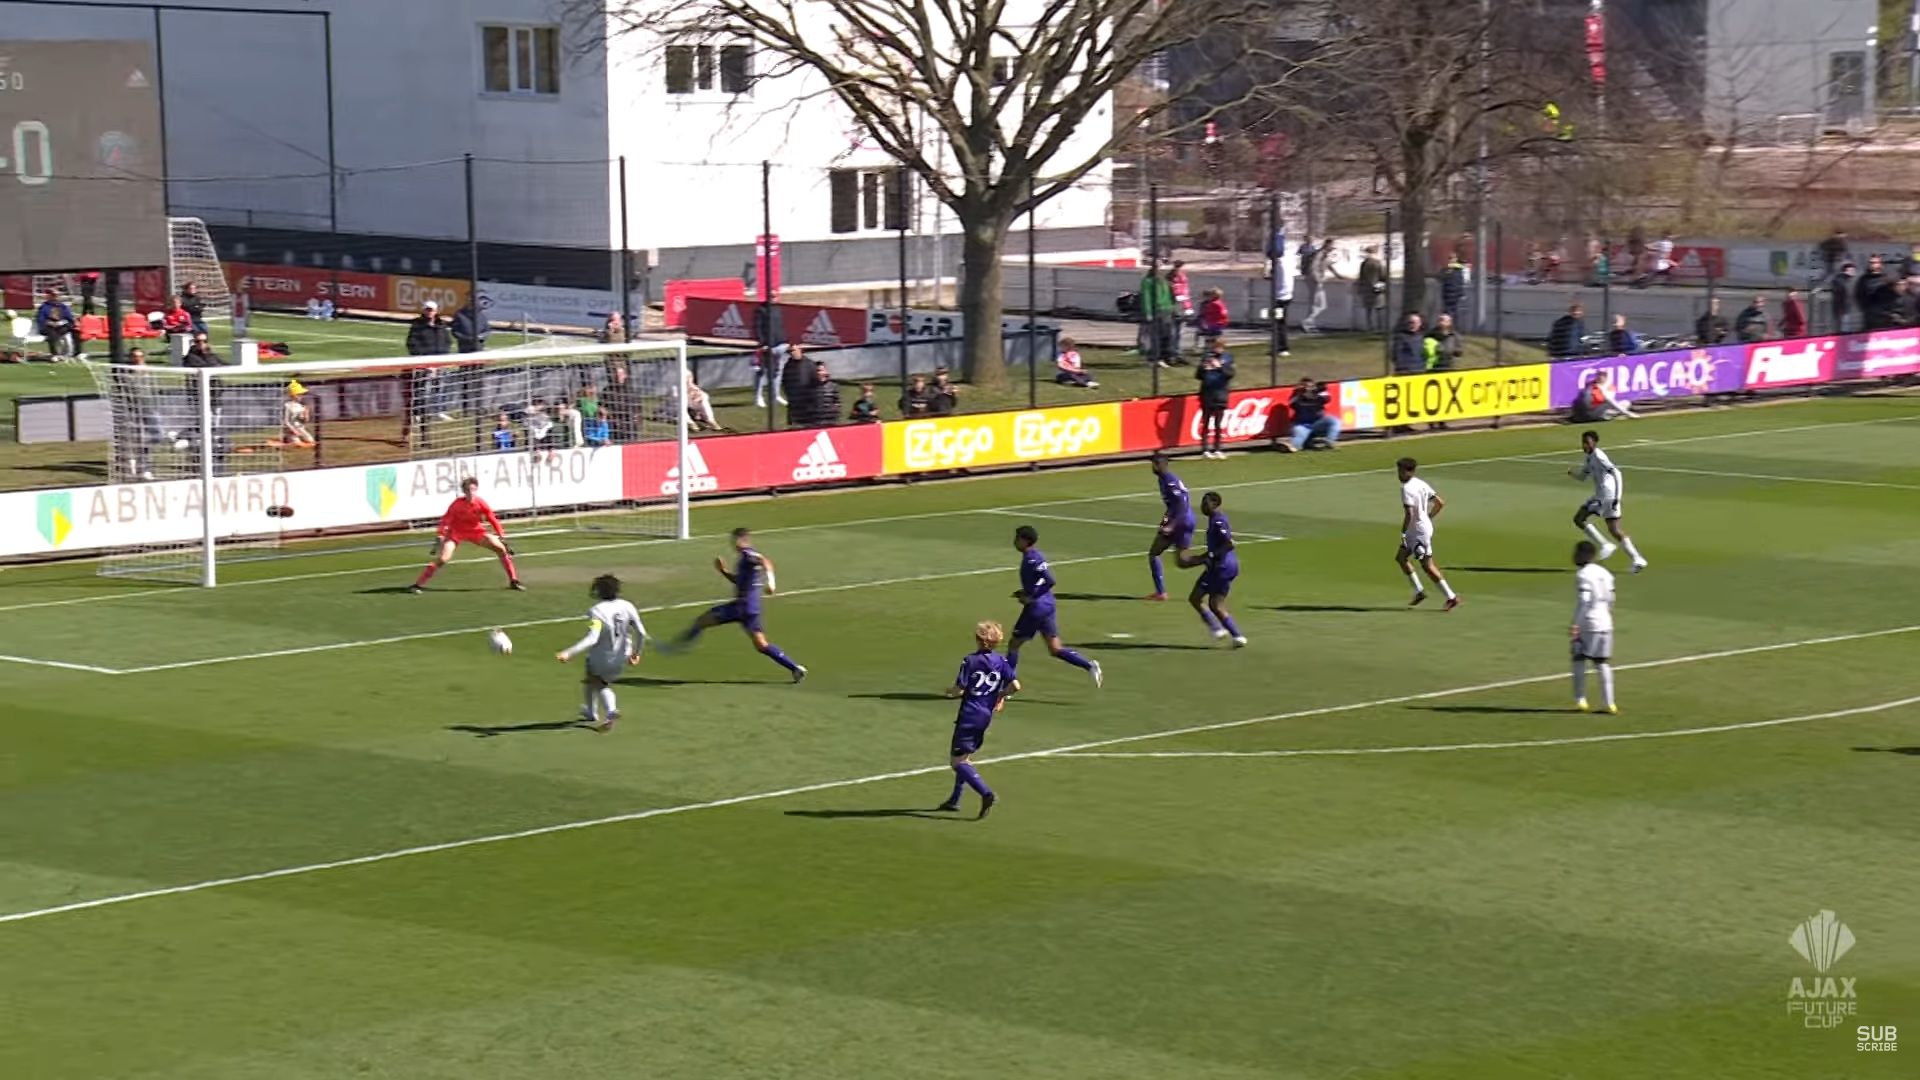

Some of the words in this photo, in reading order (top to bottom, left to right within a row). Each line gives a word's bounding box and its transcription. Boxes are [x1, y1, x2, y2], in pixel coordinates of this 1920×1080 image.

[318, 281, 376, 299] STERN
[1384, 377, 1464, 420] BLOX
[1471, 377, 1542, 409] crypto
[792, 463, 847, 481] adidas
[660, 476, 718, 495] addas
[970, 671, 1001, 696] 29
